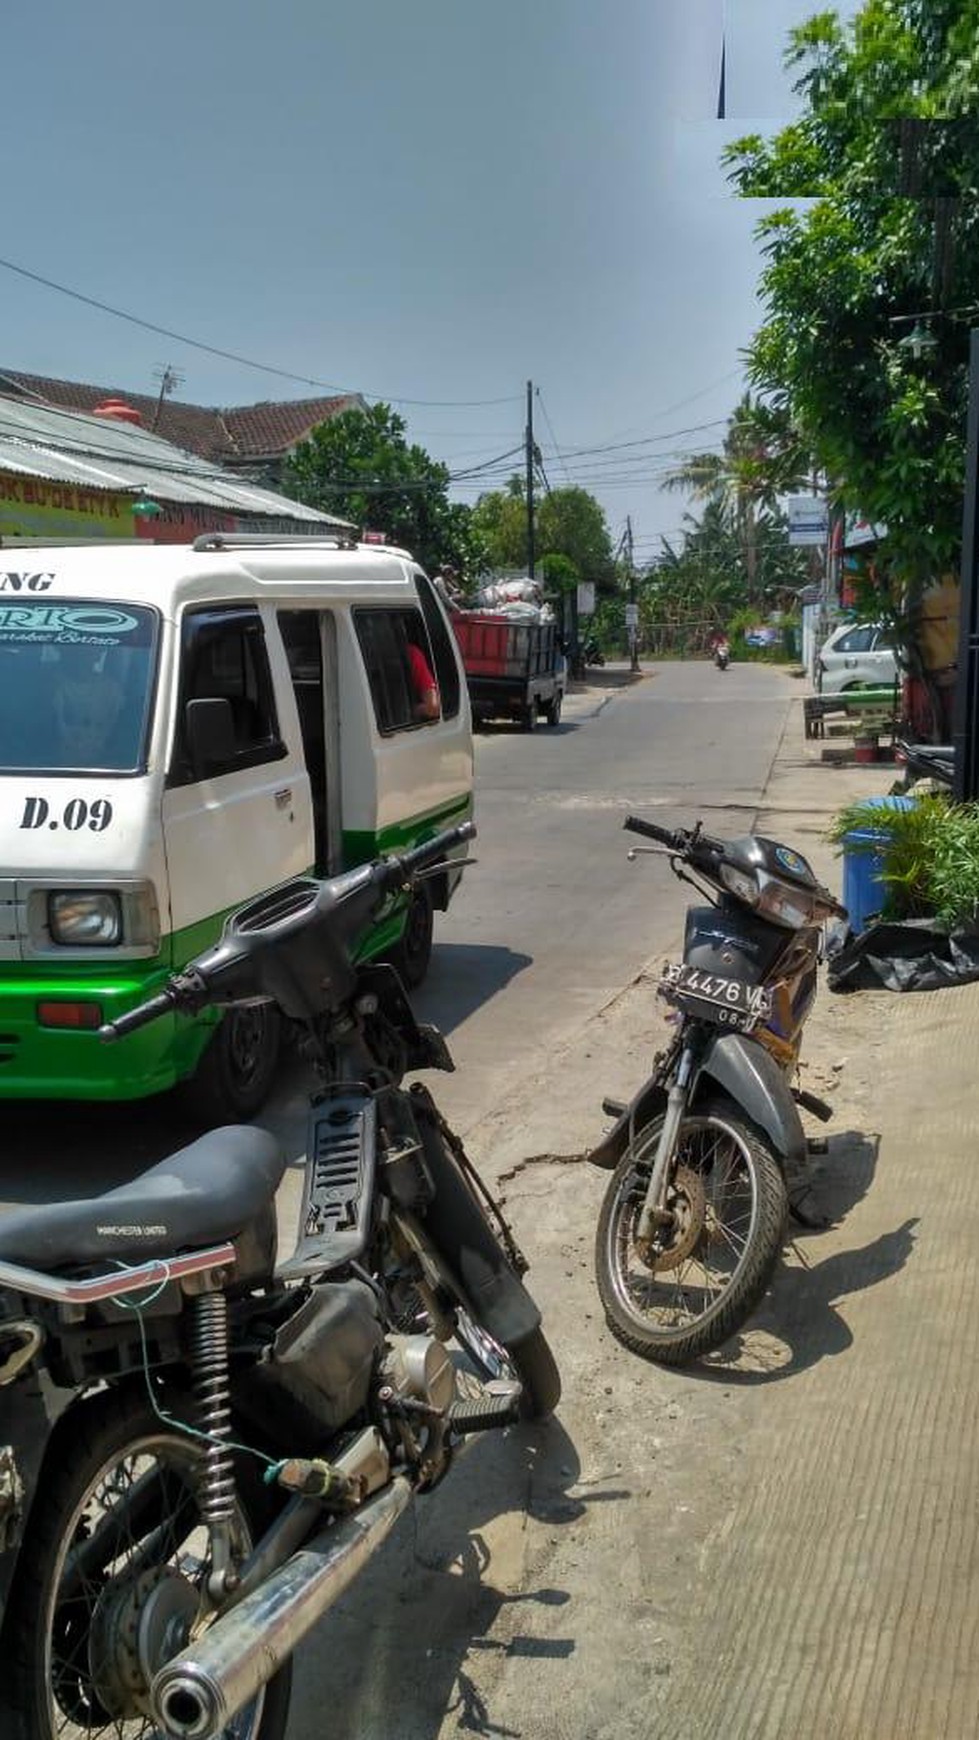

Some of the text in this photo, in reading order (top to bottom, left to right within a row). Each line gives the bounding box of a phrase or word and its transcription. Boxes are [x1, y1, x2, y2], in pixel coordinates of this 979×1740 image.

[0, 572, 56, 591] NG
[19, 797, 113, 832] D.09
[687, 971, 741, 1002] 4476
